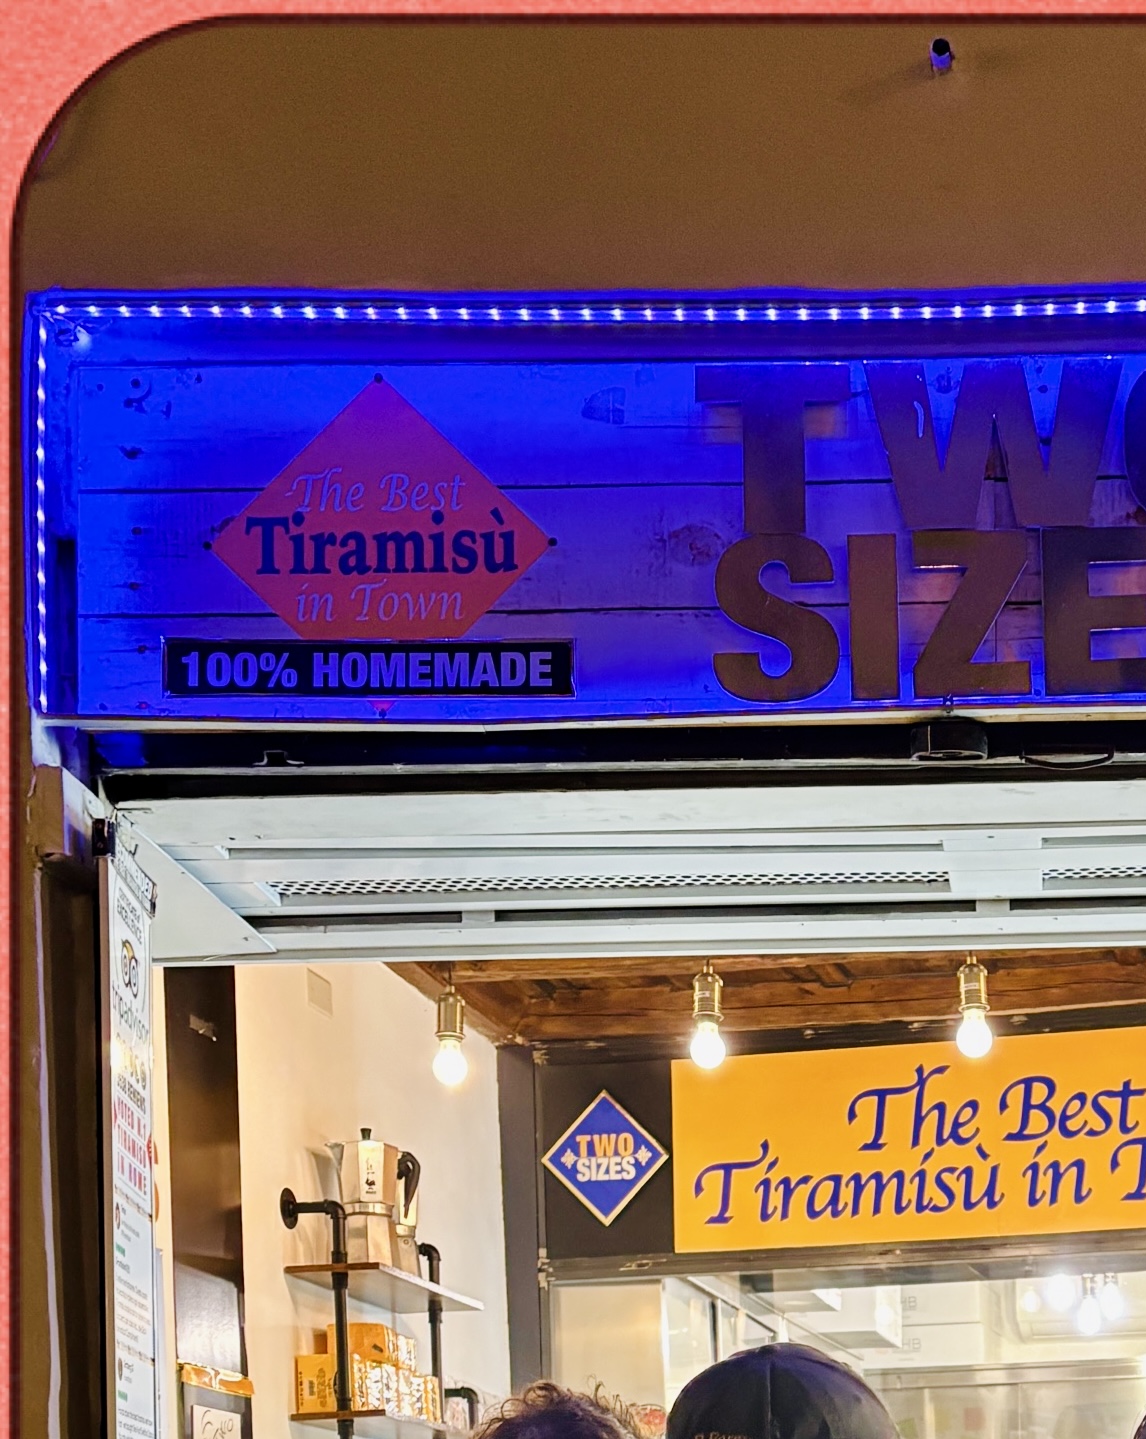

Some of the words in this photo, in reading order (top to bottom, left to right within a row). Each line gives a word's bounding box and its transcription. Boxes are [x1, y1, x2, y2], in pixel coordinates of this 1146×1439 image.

[285, 467, 366, 514] The
[380, 473, 466, 512] Best
[245, 507, 518, 577] Tiramisù
[296, 583, 333, 624] in
[349, 579, 466, 623] Town
[181, 651, 298, 688] 100%
[312, 651, 553, 688] HOMEMADE
[117, 897, 142, 945] EXCELLENCE
[112, 980, 149, 1045] tripadvisor
[117, 1094, 134, 1130] VOTED
[847, 1063, 981, 1152] The
[575, 1132, 634, 1159] TWO
[575, 1155, 636, 1182] SIZES
[128, 1162, 147, 1196] ROME
[694, 1139, 1004, 1226] Tiramisù
[1022, 1140, 1092, 1209] in
